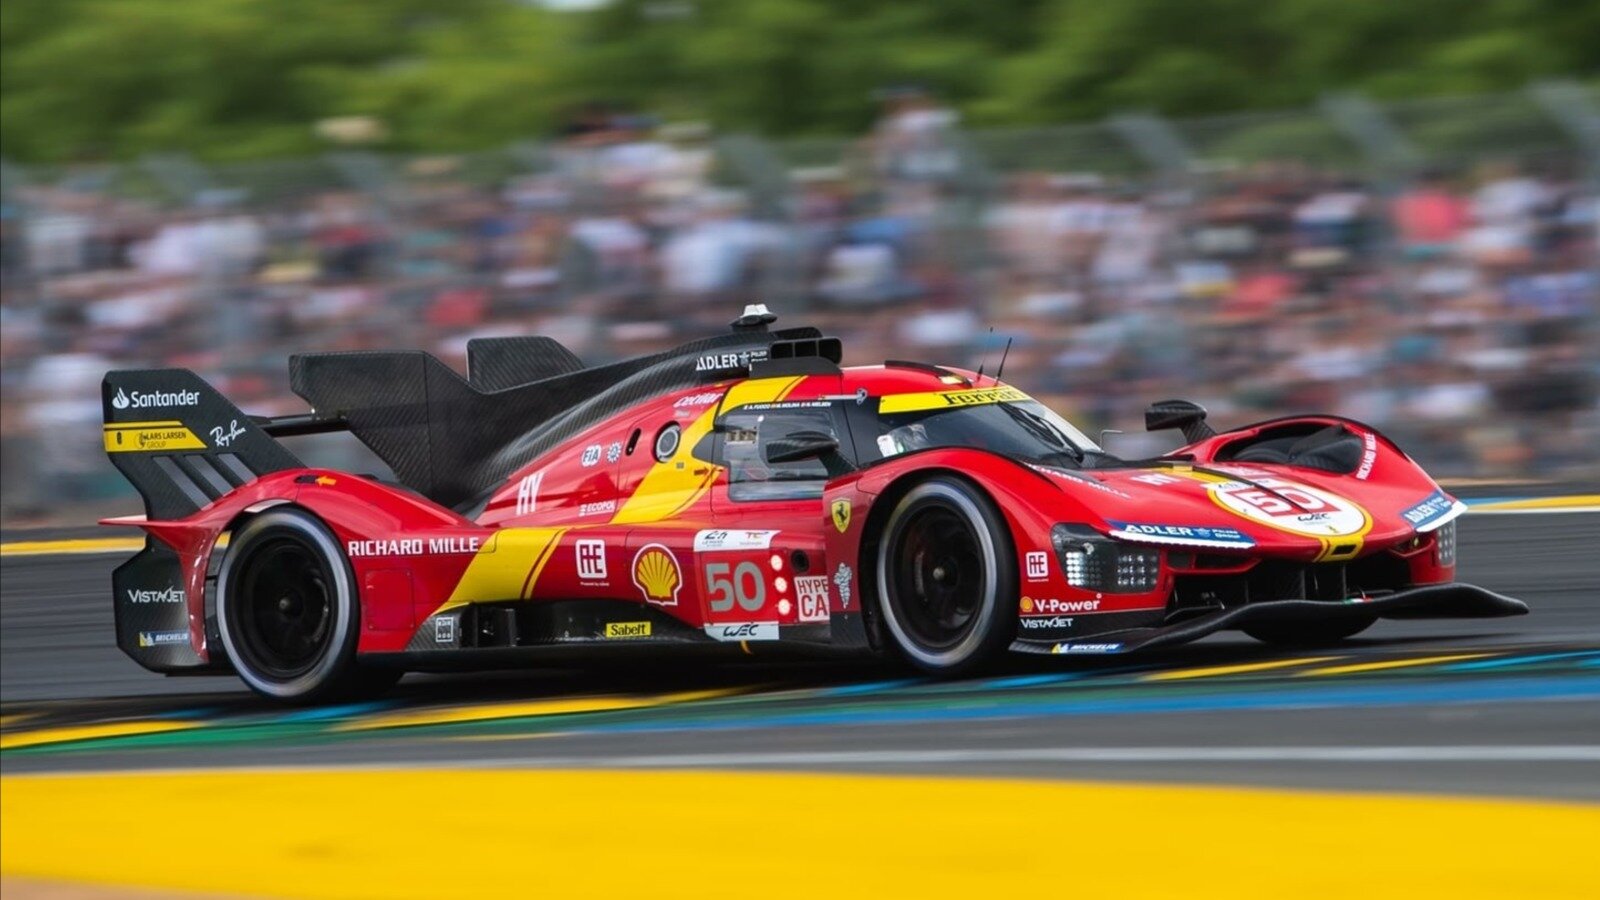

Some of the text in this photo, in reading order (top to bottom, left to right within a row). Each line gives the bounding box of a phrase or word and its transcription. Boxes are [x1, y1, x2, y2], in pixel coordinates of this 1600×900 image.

[696, 354, 739, 371] ADLER
[131, 389, 200, 408] Santander
[943, 386, 1025, 404] Ferrari
[162, 432, 187, 440] LARSEN
[582, 449, 600, 463] FIA
[516, 472, 544, 516] HY
[587, 501, 615, 512] ECOPOL
[1124, 524, 1194, 536] ADLER
[348, 537, 480, 556] RICHARD MILLE
[705, 561, 766, 612] 50
[797, 579, 828, 594] HYPE
[1034, 599, 1101, 613] V-Power
[611, 624, 646, 636] Sabelt
[723, 624, 759, 637] WEC
